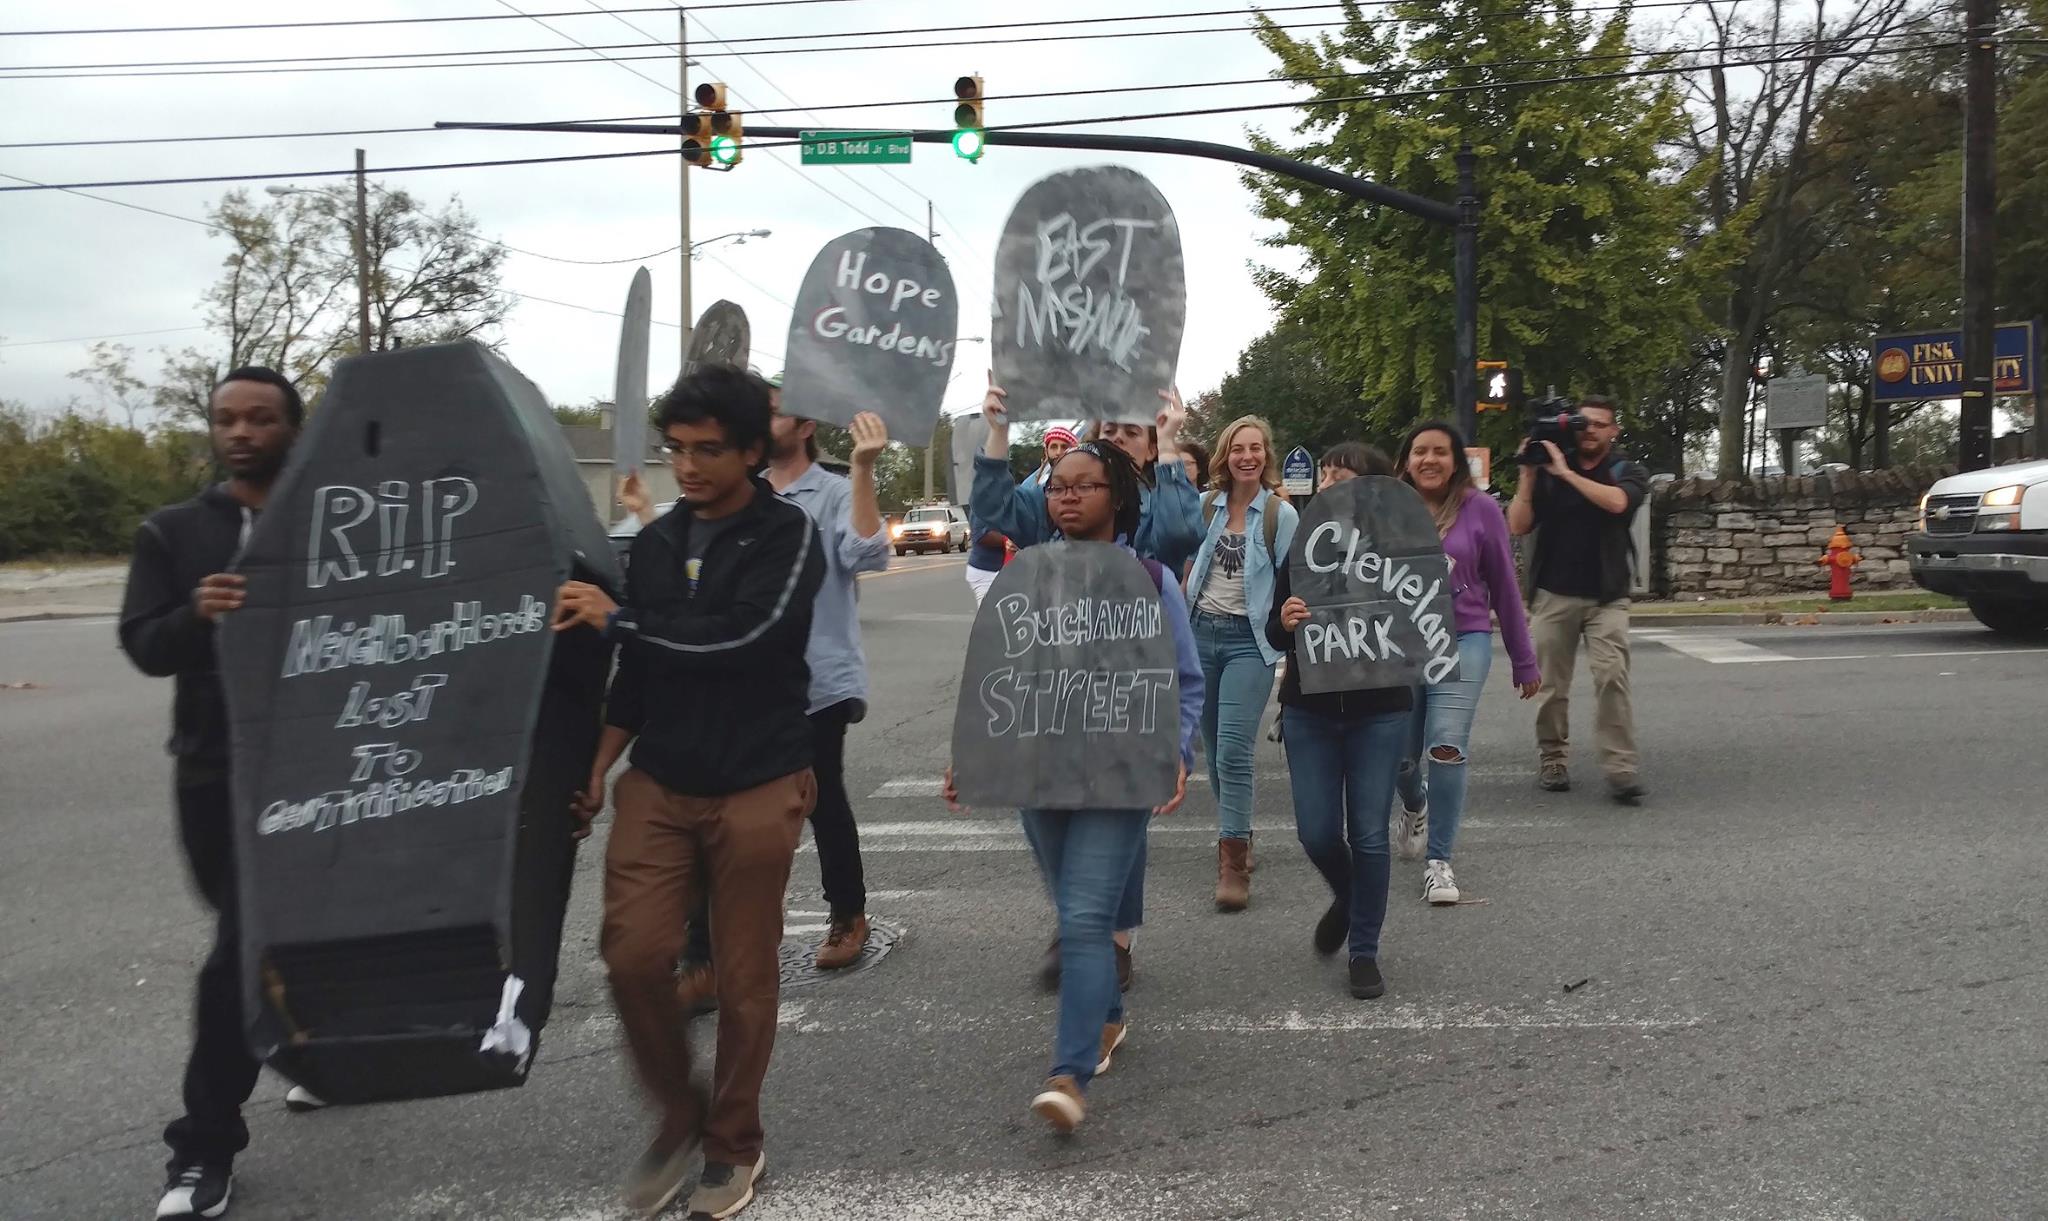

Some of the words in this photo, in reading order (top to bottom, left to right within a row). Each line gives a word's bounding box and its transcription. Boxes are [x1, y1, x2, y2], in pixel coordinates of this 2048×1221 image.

[841, 142, 869, 154] Todd
[1036, 212, 1156, 283] EAST
[836, 250, 941, 311] Hope
[1914, 341, 1954, 362] FISK
[1304, 521, 1460, 684] Cleveland
[1304, 615, 1406, 664] PARK
